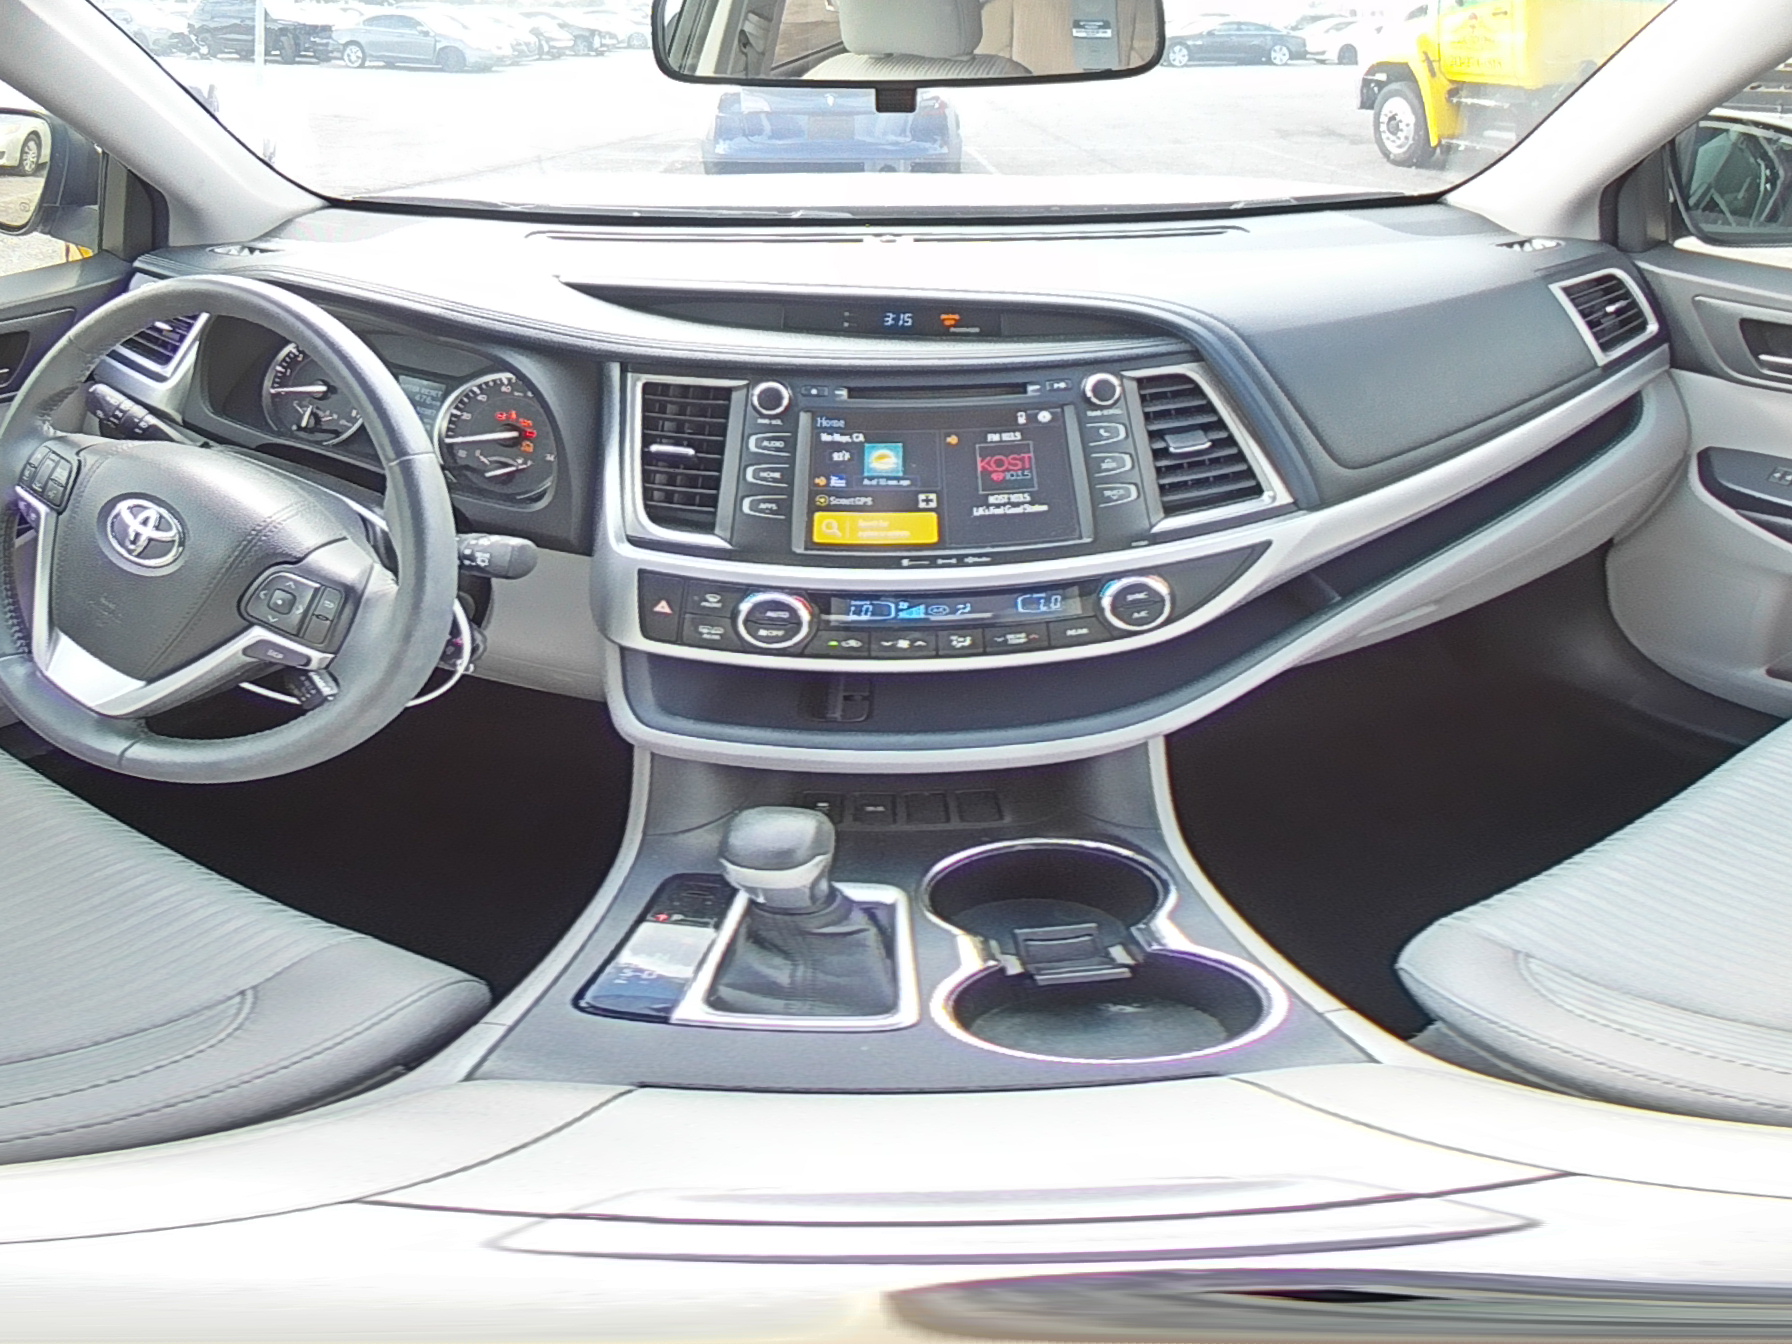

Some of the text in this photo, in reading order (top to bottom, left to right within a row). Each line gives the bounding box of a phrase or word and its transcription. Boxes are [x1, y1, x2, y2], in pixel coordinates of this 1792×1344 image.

[883, 312, 913, 327] 3:15
[815, 417, 846, 428] Home
[761, 439, 785, 448] AUDIO
[978, 453, 1033, 472] KOST
[765, 610, 790, 618] AUTO
